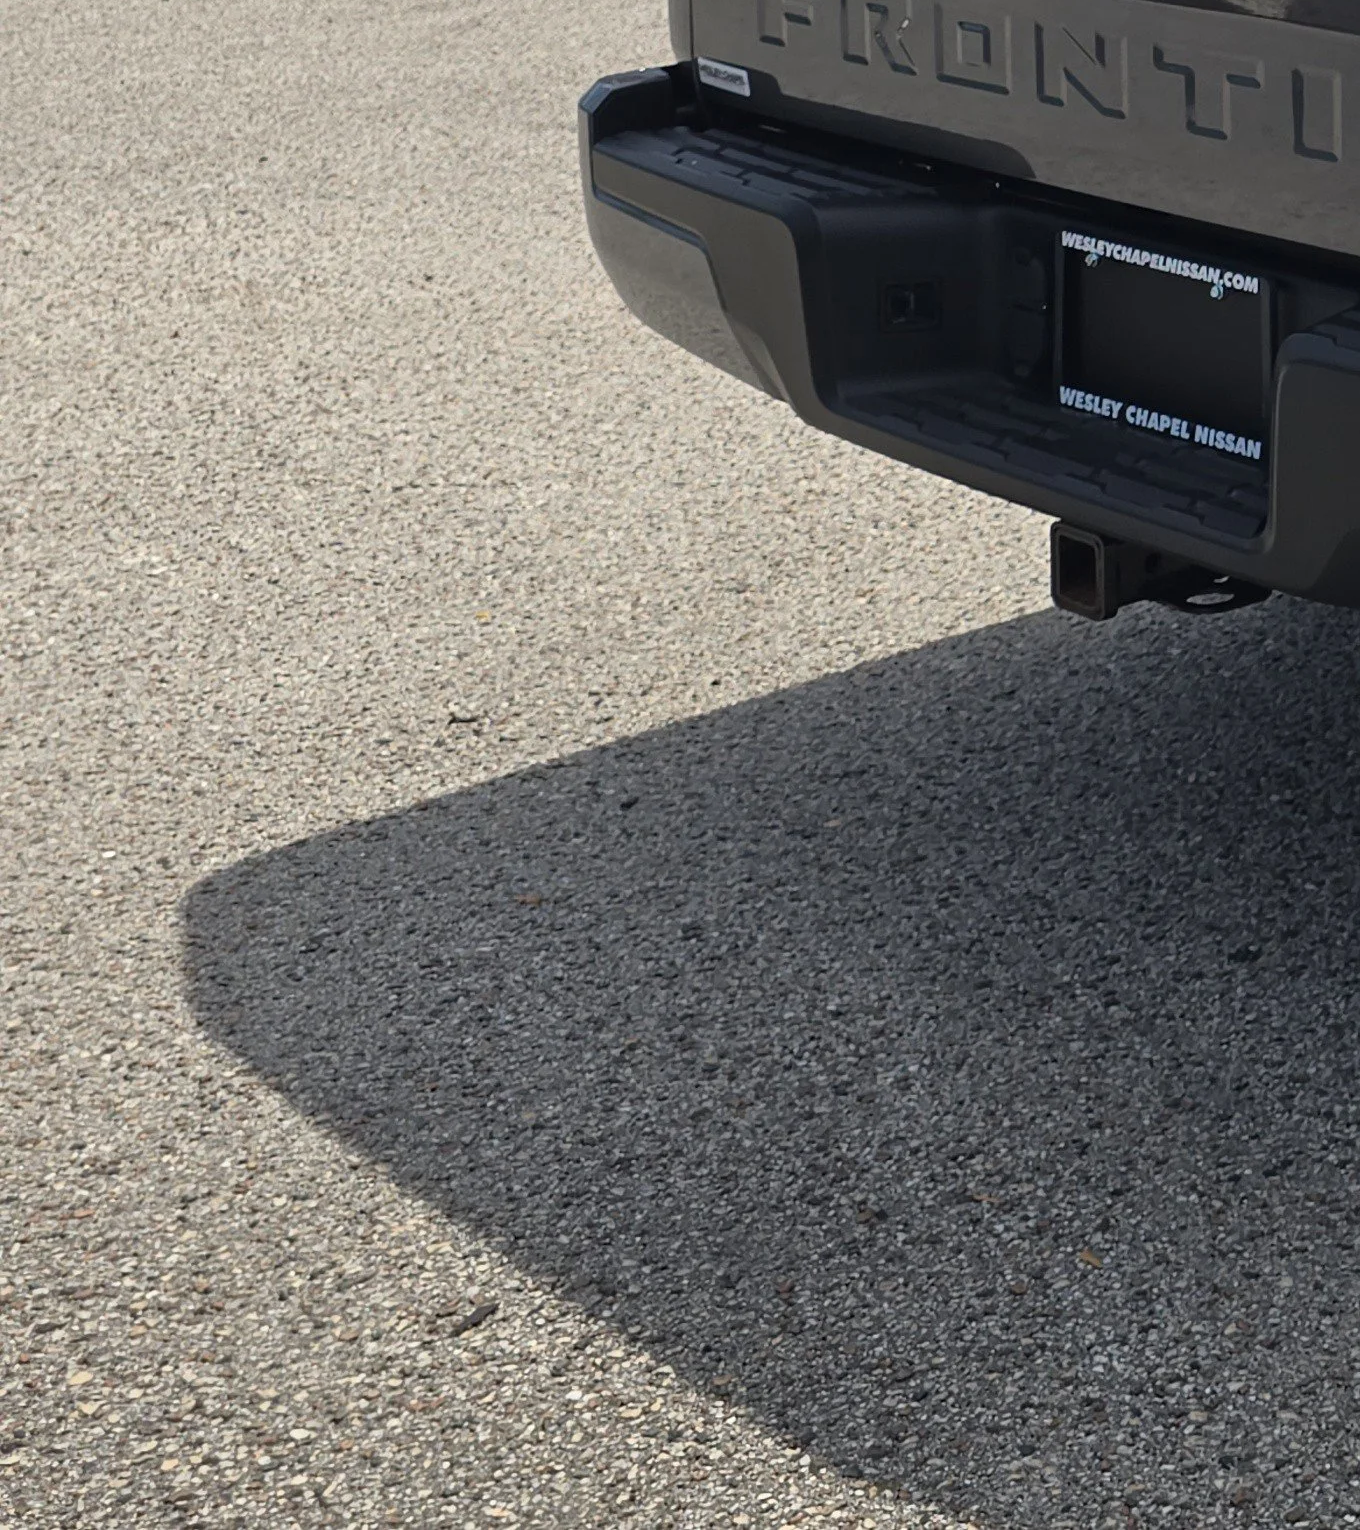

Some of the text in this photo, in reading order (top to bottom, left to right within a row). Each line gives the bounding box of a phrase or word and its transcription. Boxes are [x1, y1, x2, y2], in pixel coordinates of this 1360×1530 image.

[1060, 230, 1260, 295] WESLEYCHAPELNISSAN.COM
[1058, 385, 1262, 461] WESLEY CHAPEL NISSAN
